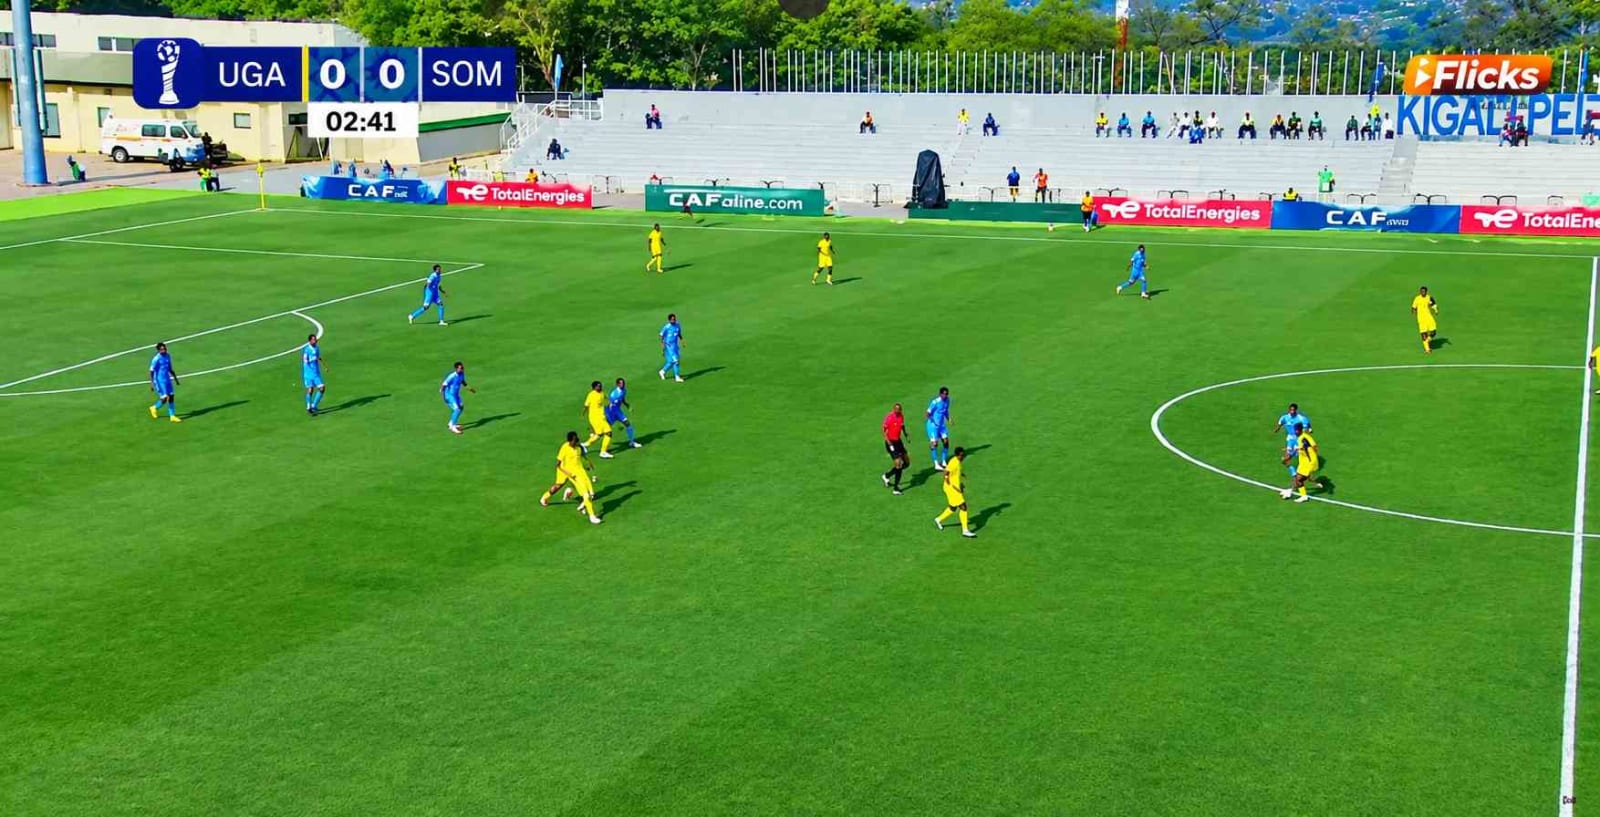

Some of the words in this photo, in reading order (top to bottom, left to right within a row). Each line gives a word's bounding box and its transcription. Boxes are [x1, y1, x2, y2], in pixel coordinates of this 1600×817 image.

[1397, 94, 1518, 136] KIGALI
[348, 184, 395, 198] CAF
[491, 186, 585, 205] TotalEnergies
[1144, 203, 1261, 224] TotalEnergies
[1326, 210, 1387, 226] CAF
[1522, 212, 1600, 229] TotalEne
